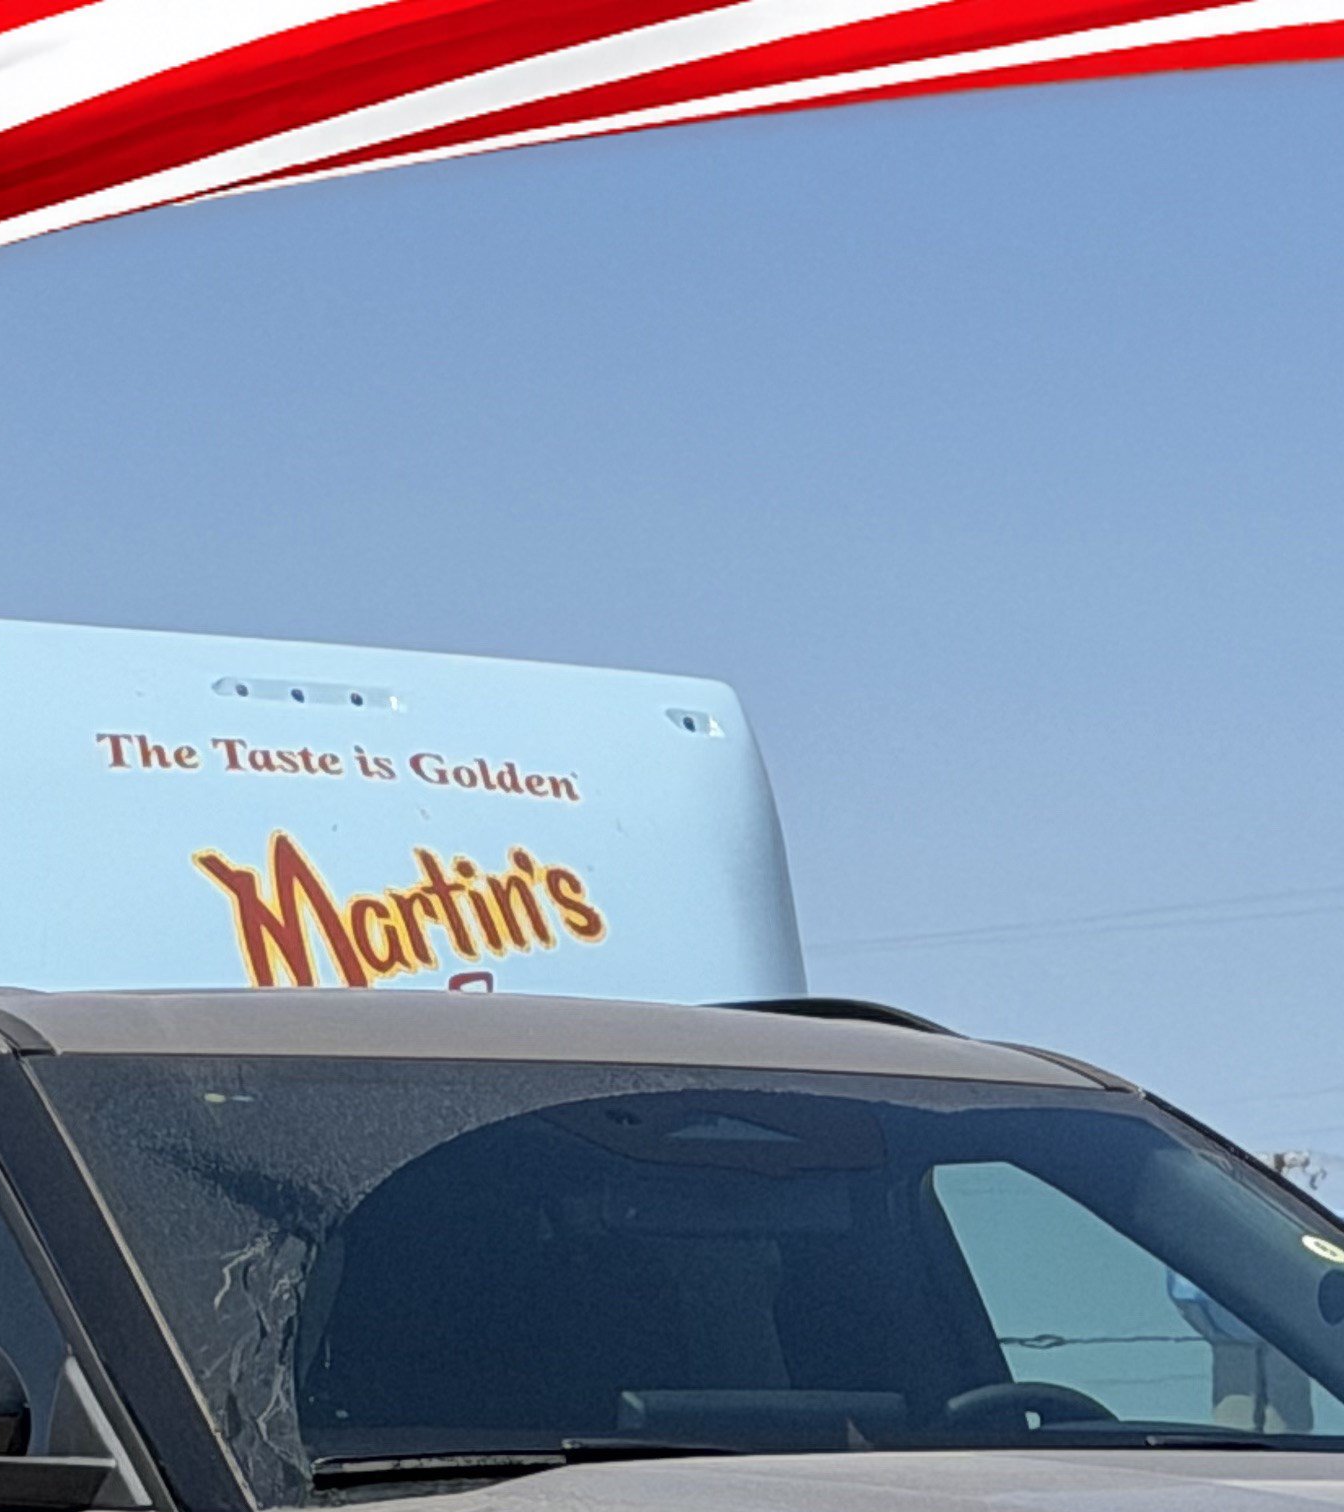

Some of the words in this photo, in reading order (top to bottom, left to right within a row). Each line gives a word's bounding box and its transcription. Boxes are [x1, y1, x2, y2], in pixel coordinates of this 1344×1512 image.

[96, 733, 199, 769] The
[212, 738, 342, 775] Taste
[355, 747, 395, 780] is
[410, 752, 579, 801] Golden
[193, 832, 605, 988] Martin's
